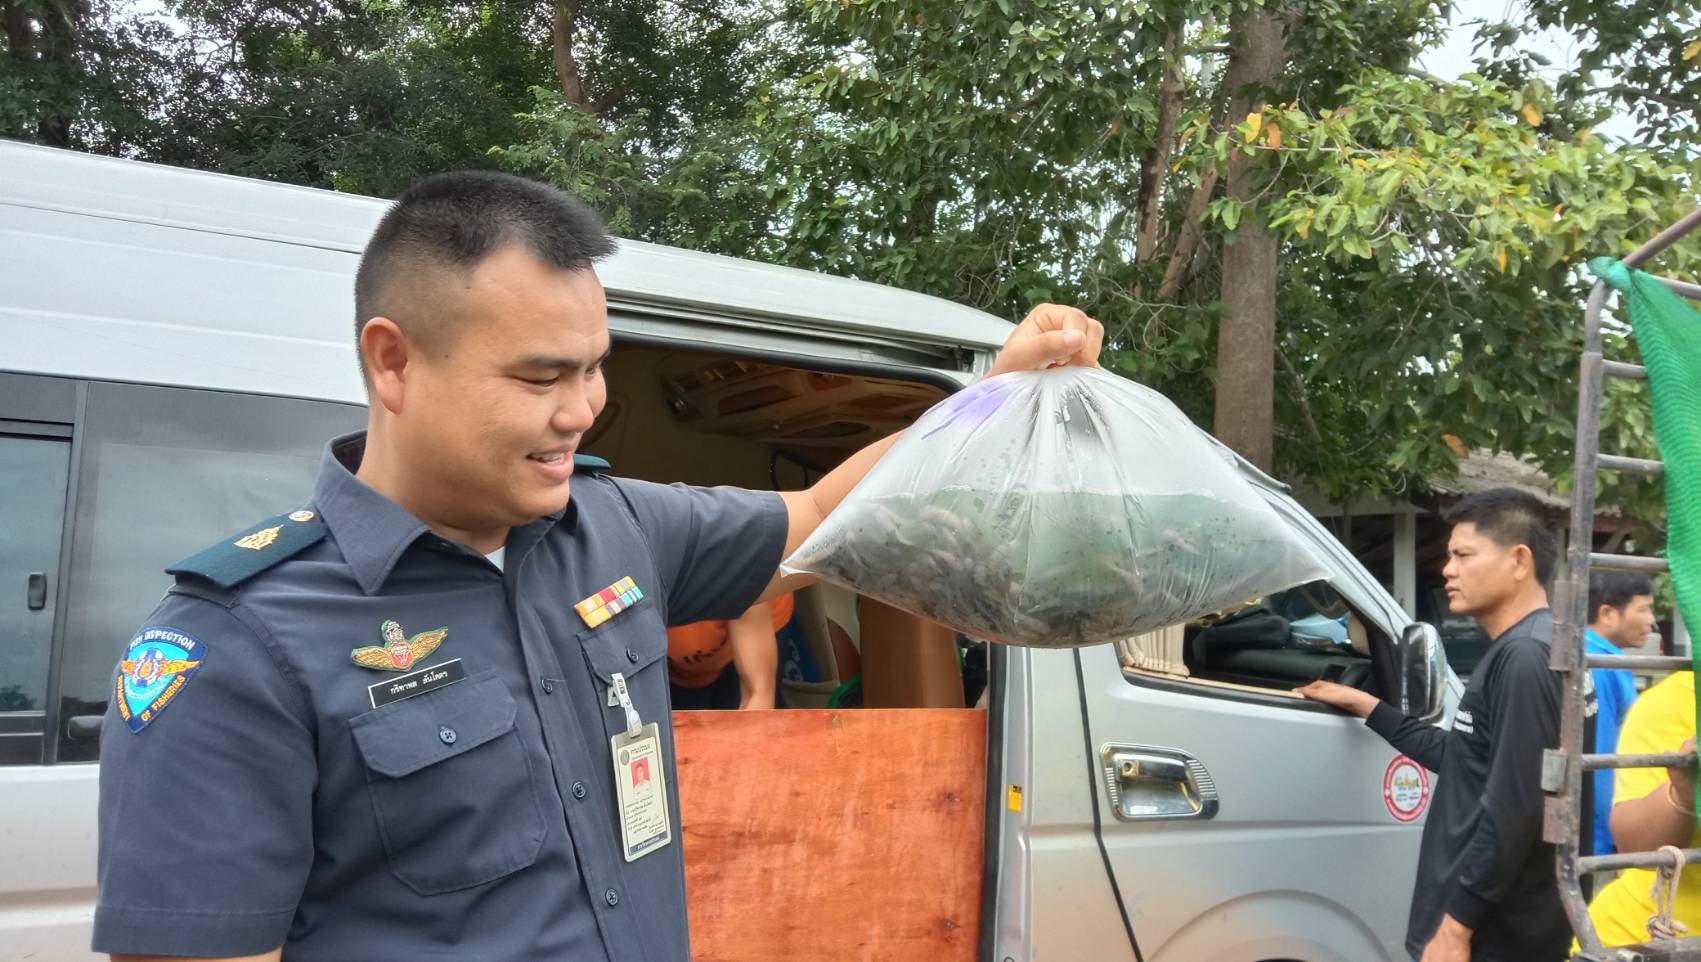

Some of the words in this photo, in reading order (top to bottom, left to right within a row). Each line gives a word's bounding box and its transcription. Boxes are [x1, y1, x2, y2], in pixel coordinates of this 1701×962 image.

[144, 629, 196, 651] INSPECTION
[141, 709, 152, 722] OF
[151, 674, 187, 712] FISHERIES
